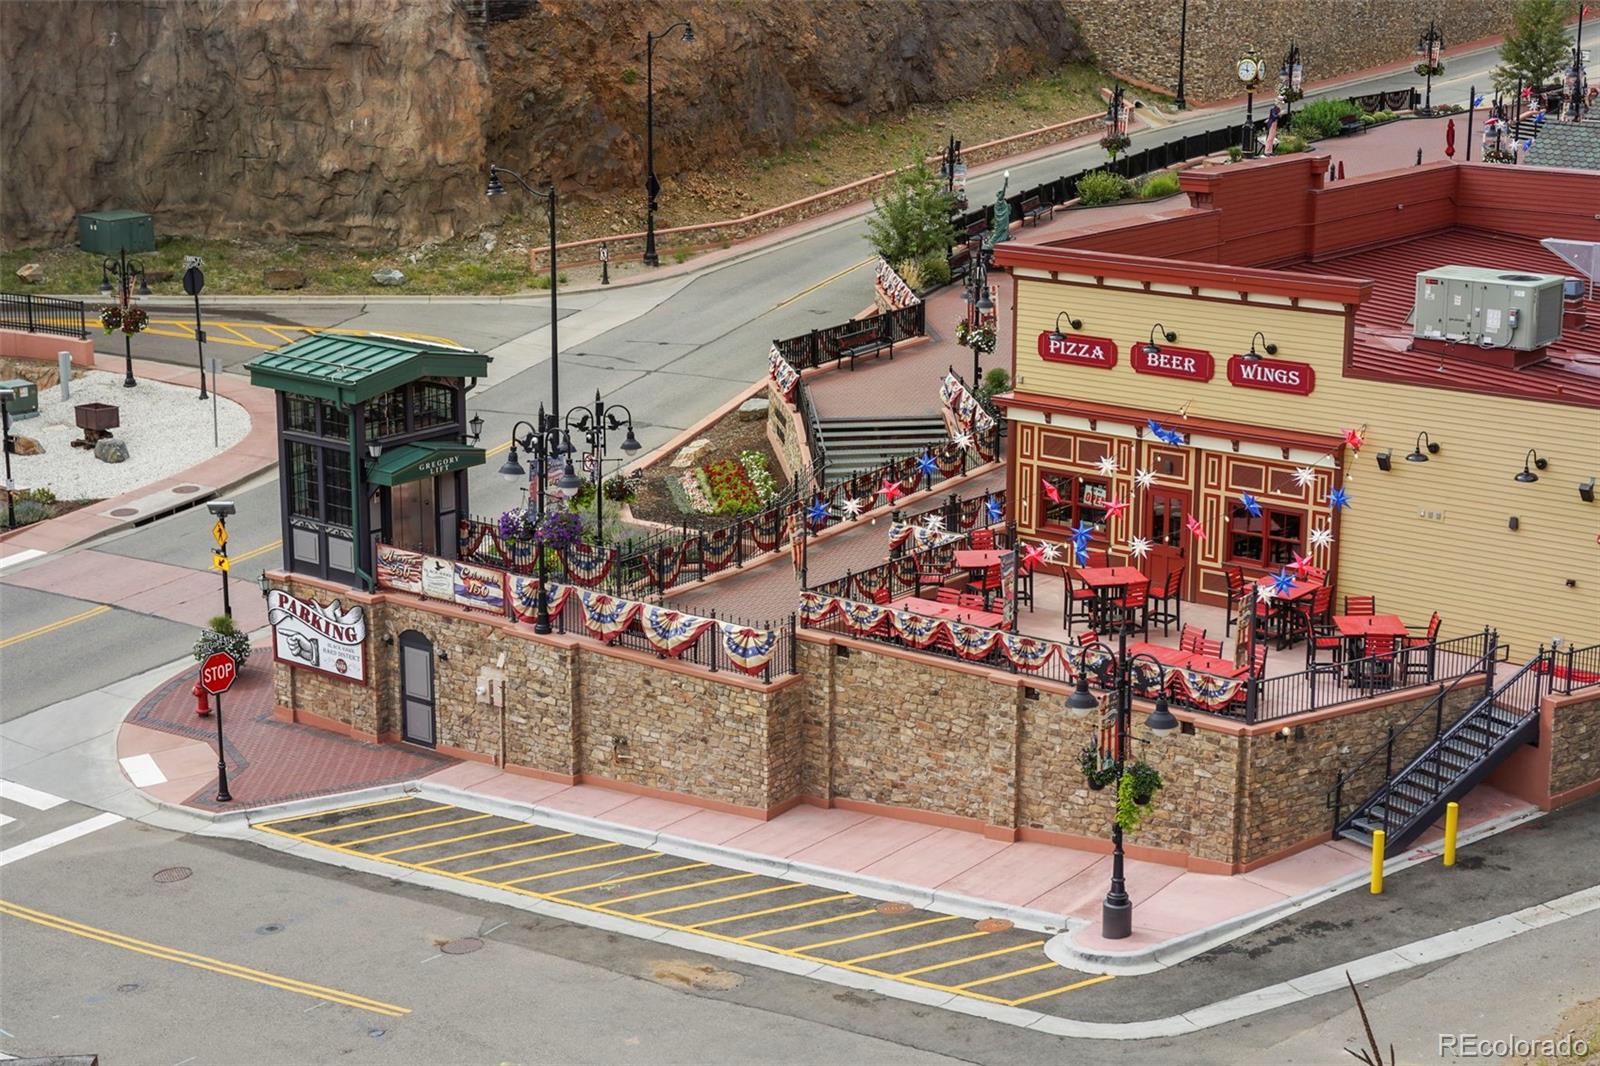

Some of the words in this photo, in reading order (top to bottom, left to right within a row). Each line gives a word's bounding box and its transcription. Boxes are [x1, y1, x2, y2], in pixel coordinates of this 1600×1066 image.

[1049, 340, 1105, 360] PIZZA
[1147, 353, 1196, 373] BEER
[1240, 364, 1300, 385] WINGS
[419, 455, 460, 471] GREGORY
[430, 464, 450, 475] LIFT
[468, 582, 490, 598] 150
[278, 593, 358, 642] PARKING
[204, 663, 233, 683] STOP
